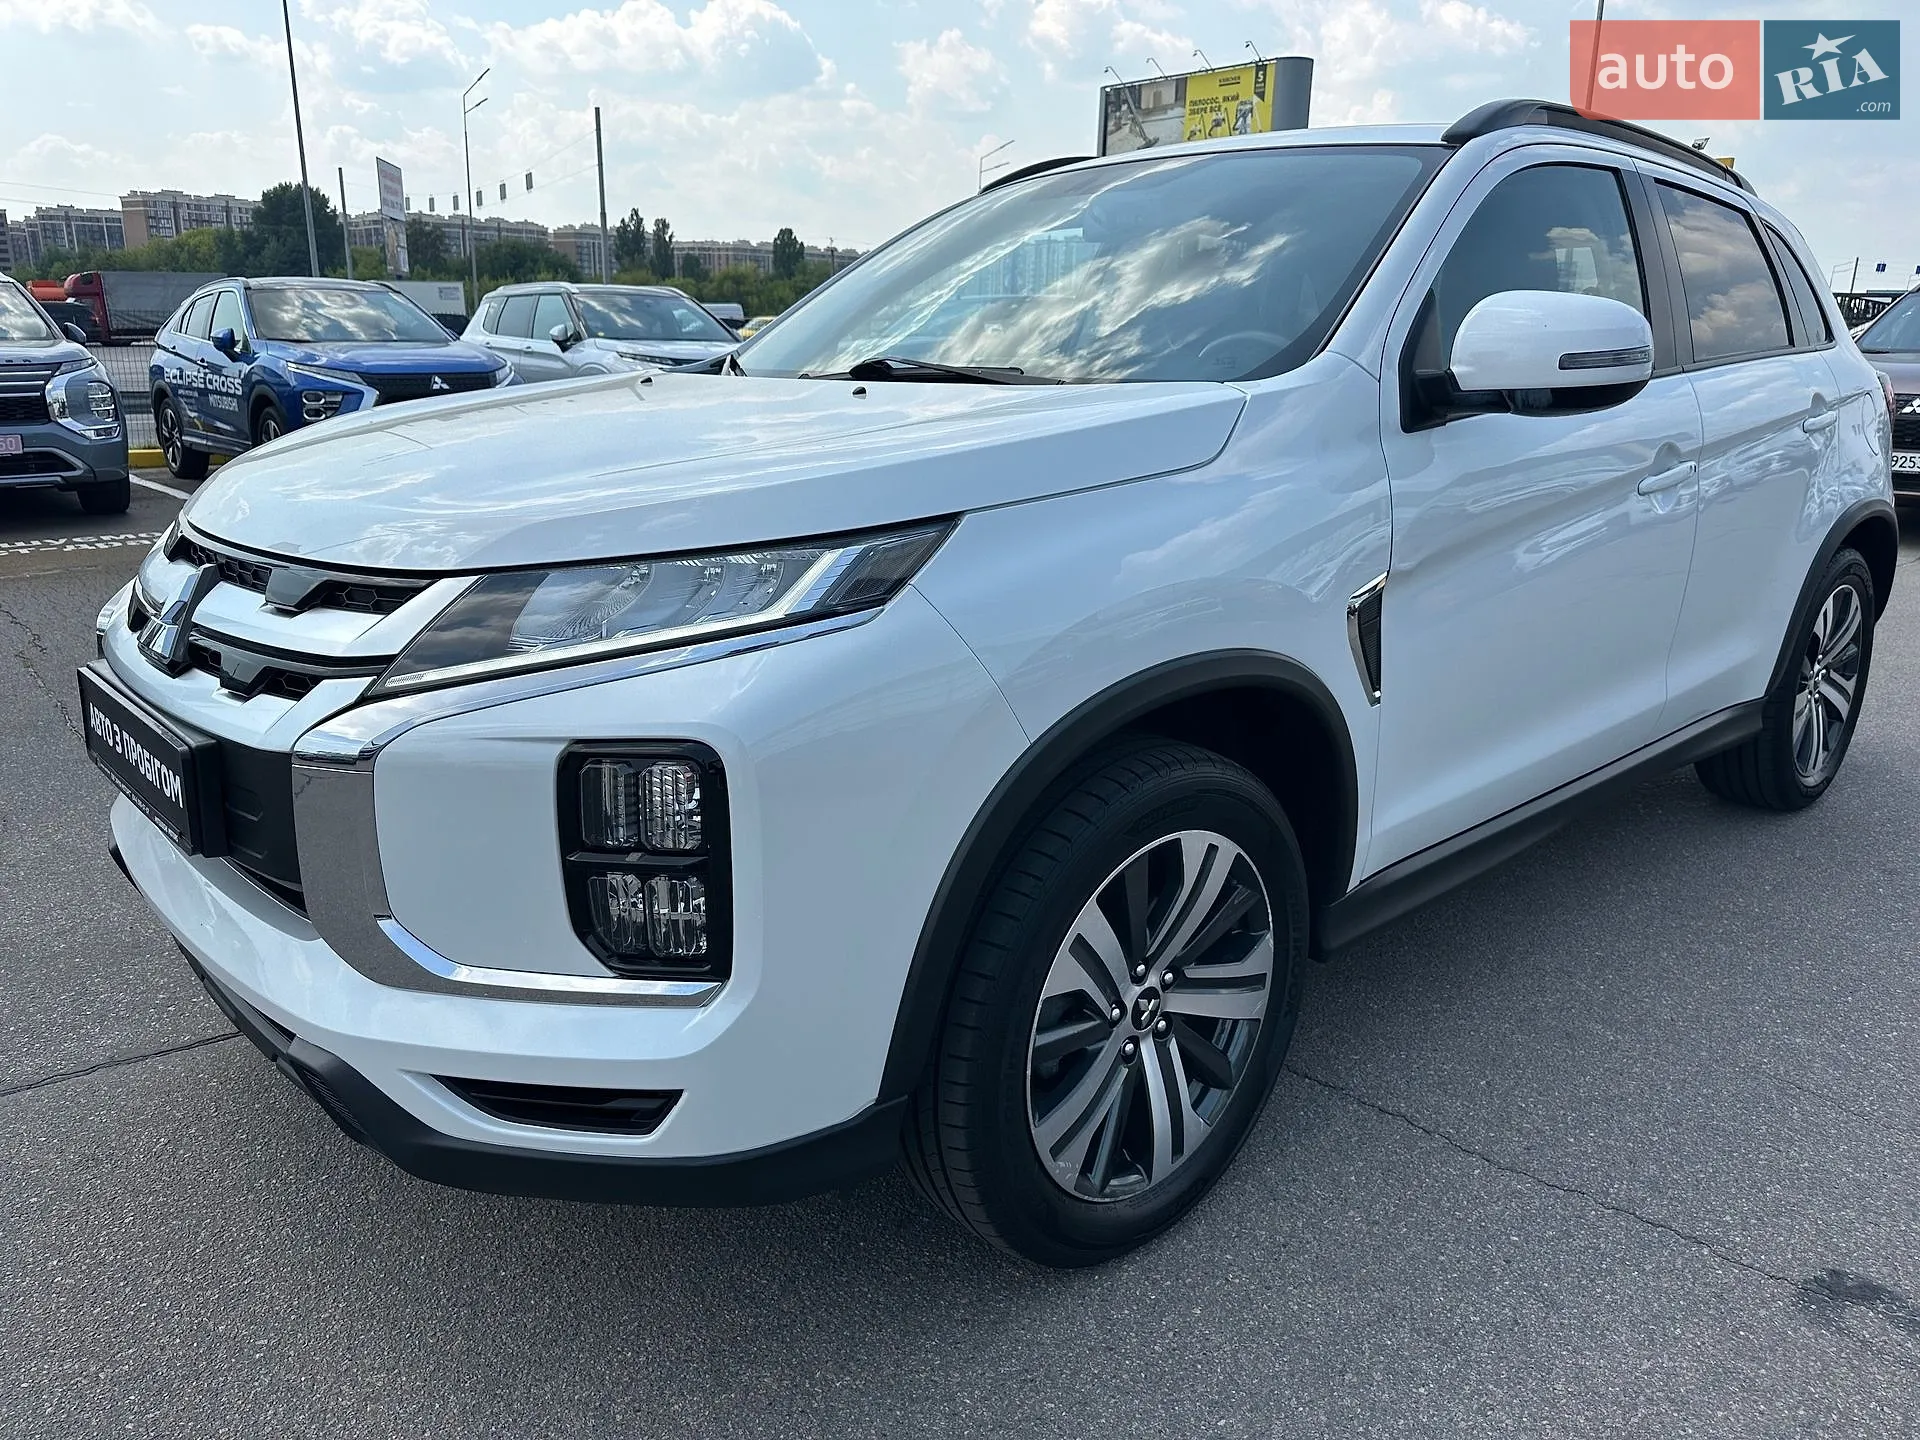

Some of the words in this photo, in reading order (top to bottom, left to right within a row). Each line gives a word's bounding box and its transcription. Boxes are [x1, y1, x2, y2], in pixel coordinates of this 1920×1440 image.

[1257, 71, 1264, 82] 5
[164, 367, 205, 388] ECLIPSE
[206, 373, 243, 396] CROSS
[89, 701, 114, 747] АВТО
[113, 723, 122, 754] З
[122, 730, 183, 808] ПРОБІГОМ
